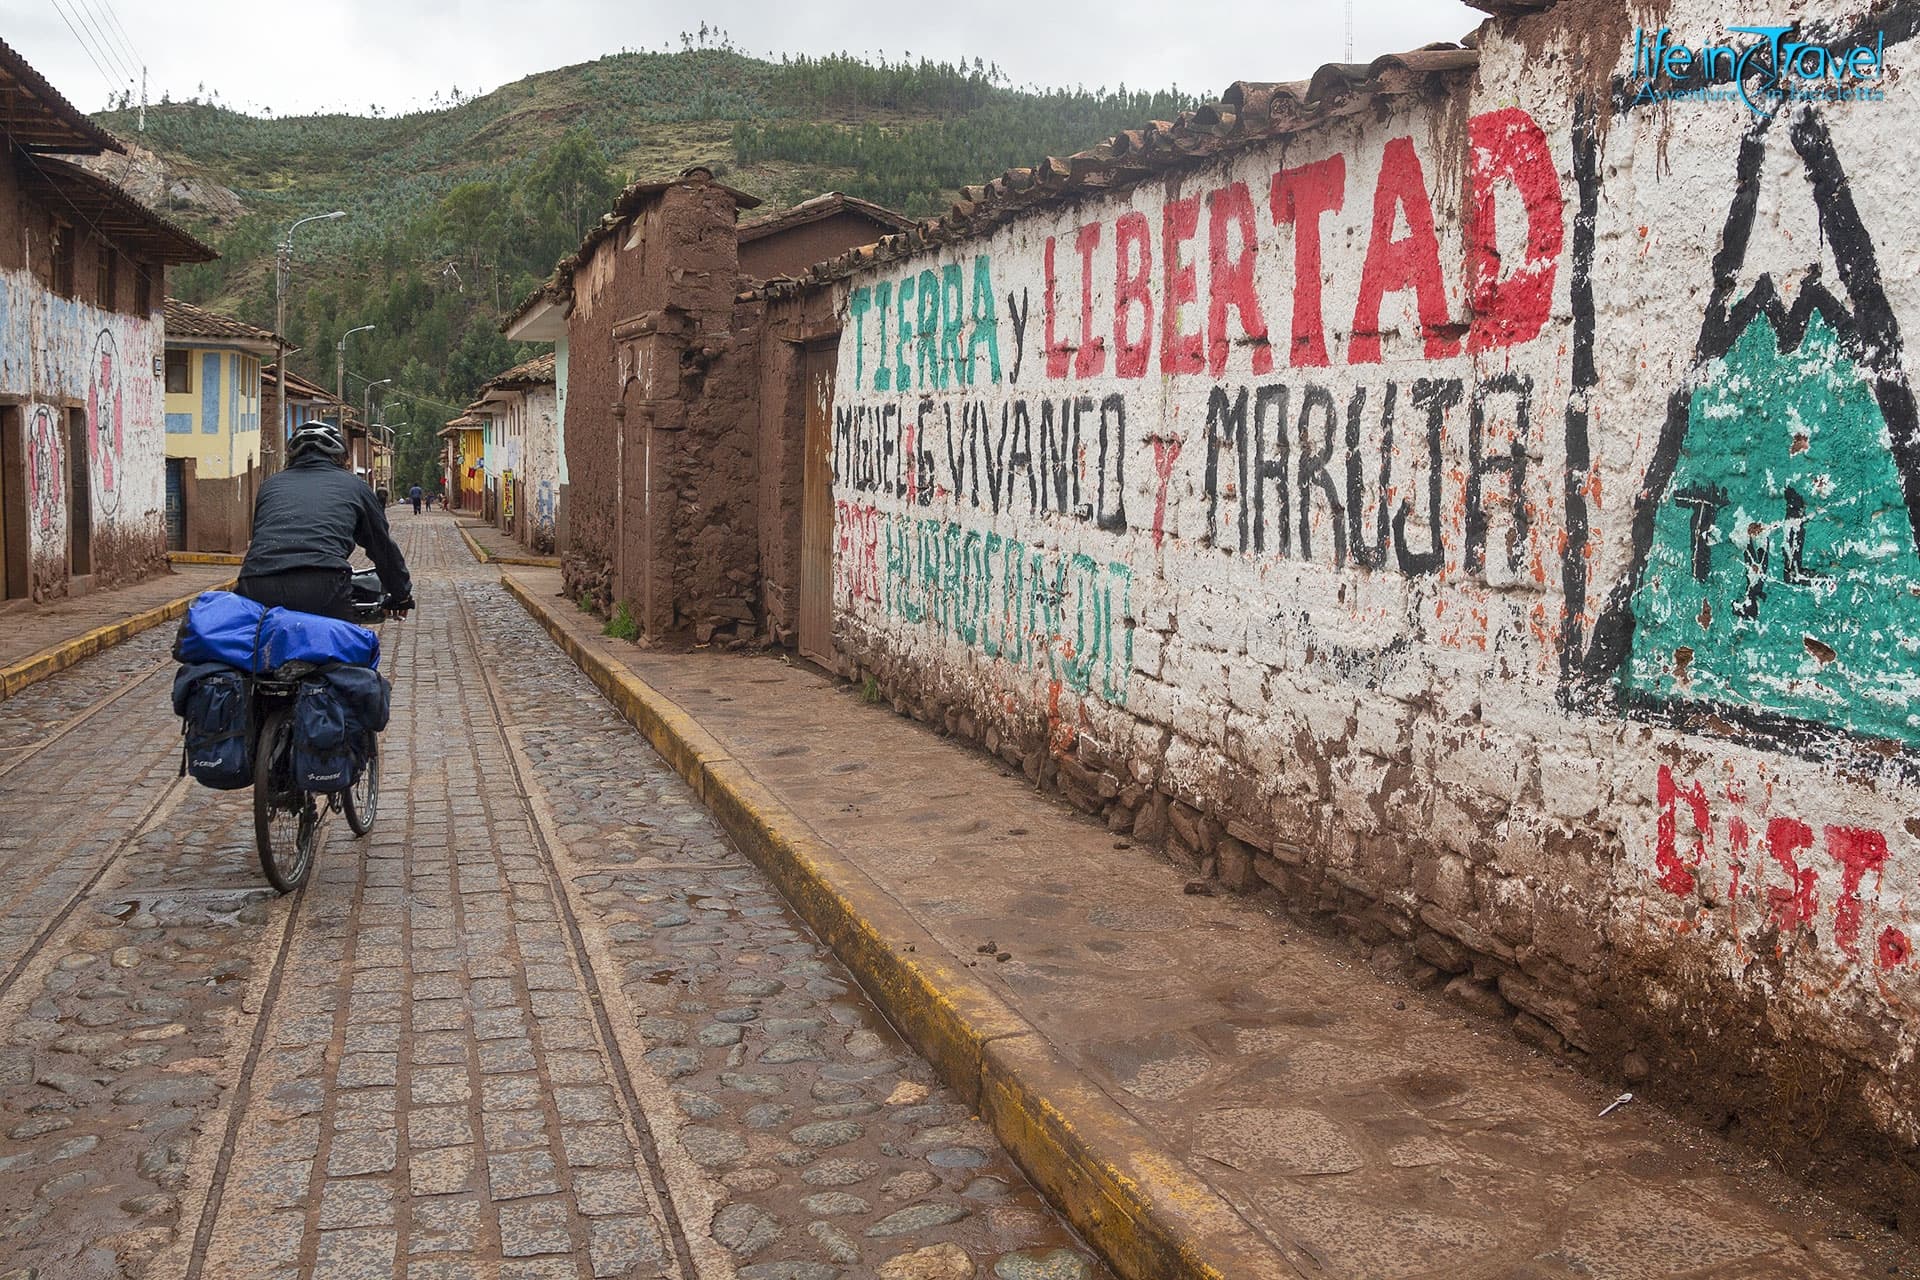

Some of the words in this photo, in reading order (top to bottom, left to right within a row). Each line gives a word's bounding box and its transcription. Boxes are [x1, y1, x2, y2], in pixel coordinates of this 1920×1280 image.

[850, 255, 1000, 391] TIERRA
[1044, 107, 1563, 379] LIBERTAD
[833, 402, 906, 499] MIGUEL
[942, 393, 1127, 536] VIVANCO
